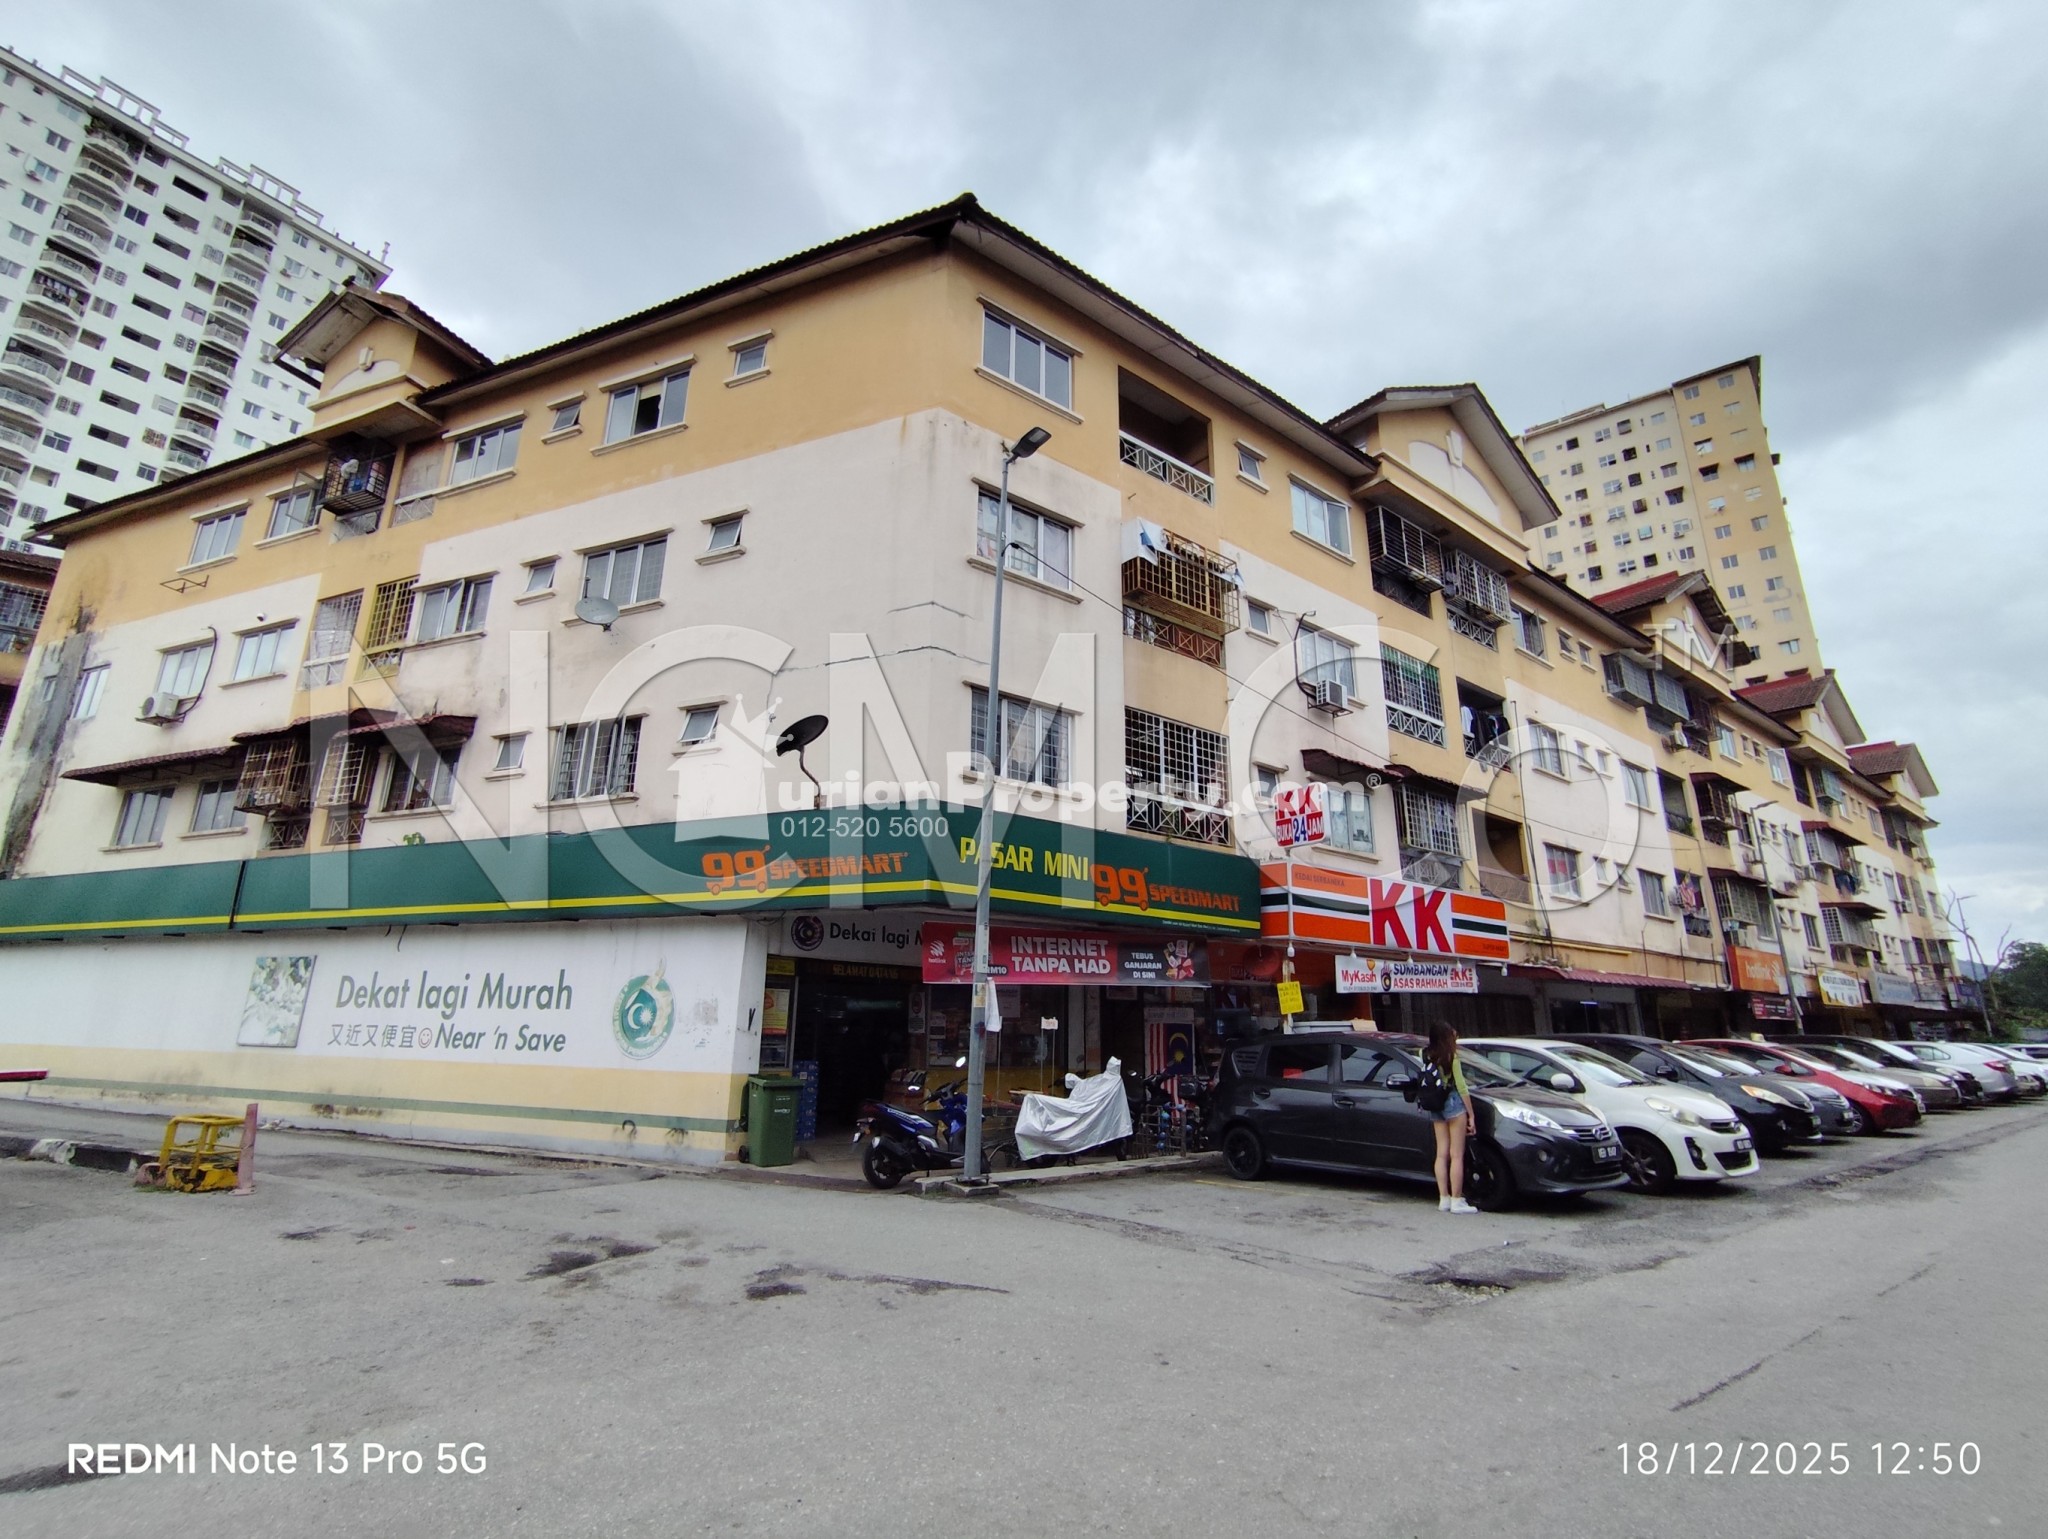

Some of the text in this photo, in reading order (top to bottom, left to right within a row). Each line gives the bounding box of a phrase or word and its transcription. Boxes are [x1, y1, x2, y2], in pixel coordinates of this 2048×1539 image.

[1276, 784, 1319, 819] KK
[1277, 816, 1323, 842] BUKA 24 JAM
[702, 845, 909, 895] 99 SPEEDMART
[1044, 850, 1089, 881] MINI
[1090, 864, 1149, 911] 99
[1149, 883, 1241, 913] SPEEDMART
[1370, 878, 1453, 953] KK
[881, 925, 910, 950] lagi
[1011, 936, 1108, 957] INTERNET
[1012, 957, 1111, 974] TANPA HAD
[1124, 961, 1163, 970] GANJARAN
[1131, 952, 1154, 960] TEBUS
[1133, 971, 1142, 979] DI
[1341, 967, 1377, 985] MyKasih
[1393, 963, 1449, 977] SUMBANGAN
[336, 969, 573, 1020] Dekat lagi Murah
[1393, 978, 1417, 988] ASAS
[1418, 978, 1449, 989] RAHMAH
[327, 1023, 417, 1049] 又近又便宜
[433, 1022, 486, 1050] Near
[515, 1024, 566, 1053] Save
